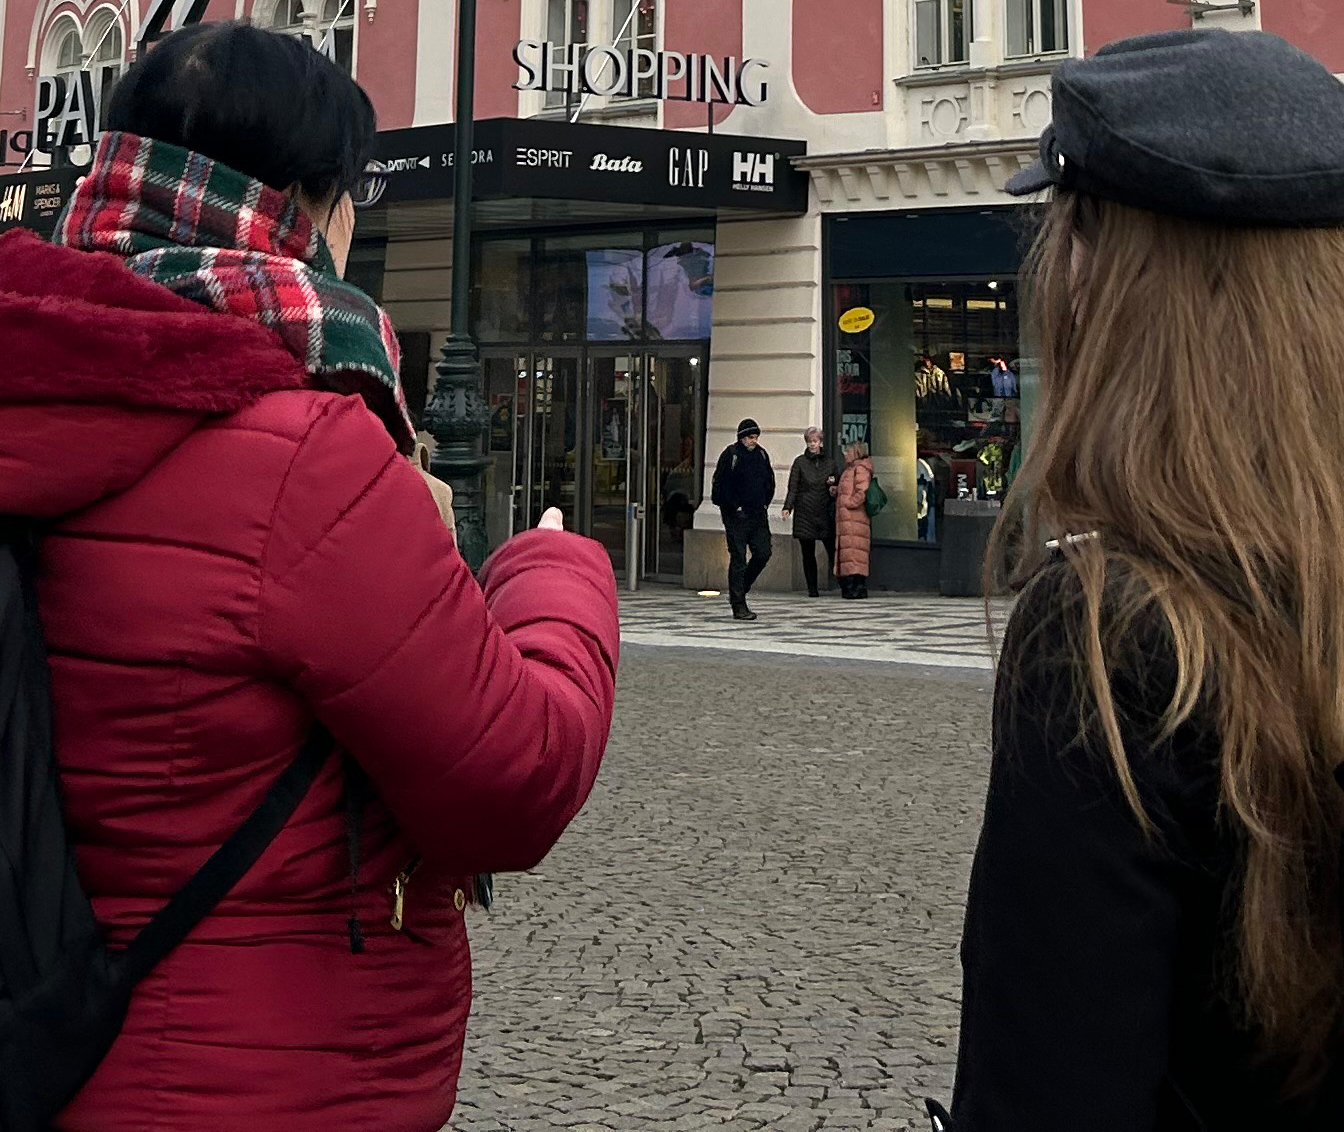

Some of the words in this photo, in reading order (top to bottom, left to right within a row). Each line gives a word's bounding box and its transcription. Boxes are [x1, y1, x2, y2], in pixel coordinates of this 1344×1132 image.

[512, 39, 770, 108] SHOPPING
[441, 150, 494, 167] SEORA
[516, 148, 573, 168] ESPRIT
[589, 153, 644, 173] Bata
[668, 146, 709, 188] GAP
[732, 151, 774, 184] HH
